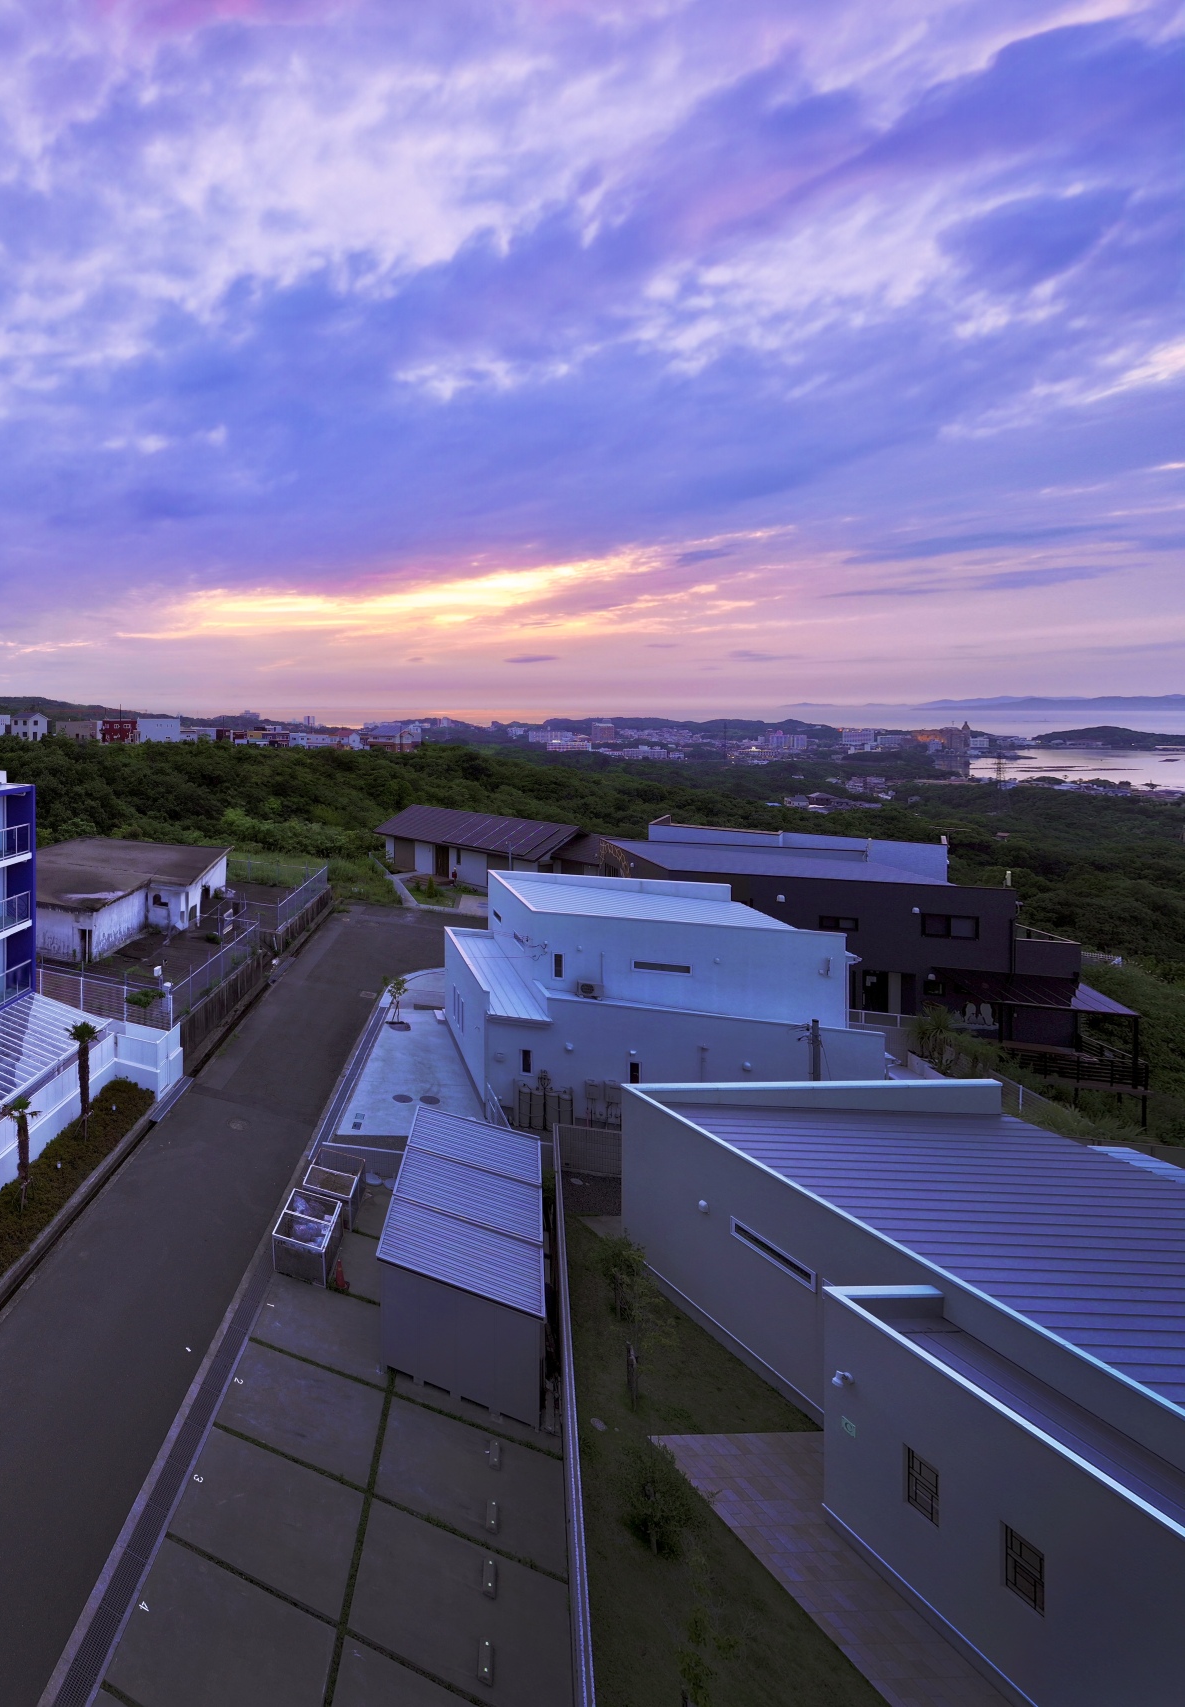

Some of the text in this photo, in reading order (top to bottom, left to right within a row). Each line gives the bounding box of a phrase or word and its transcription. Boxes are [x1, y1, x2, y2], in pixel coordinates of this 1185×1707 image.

[233, 1377, 244, 1385] 2
[193, 1474, 204, 1483] 3
[138, 1600, 150, 1612] 4
